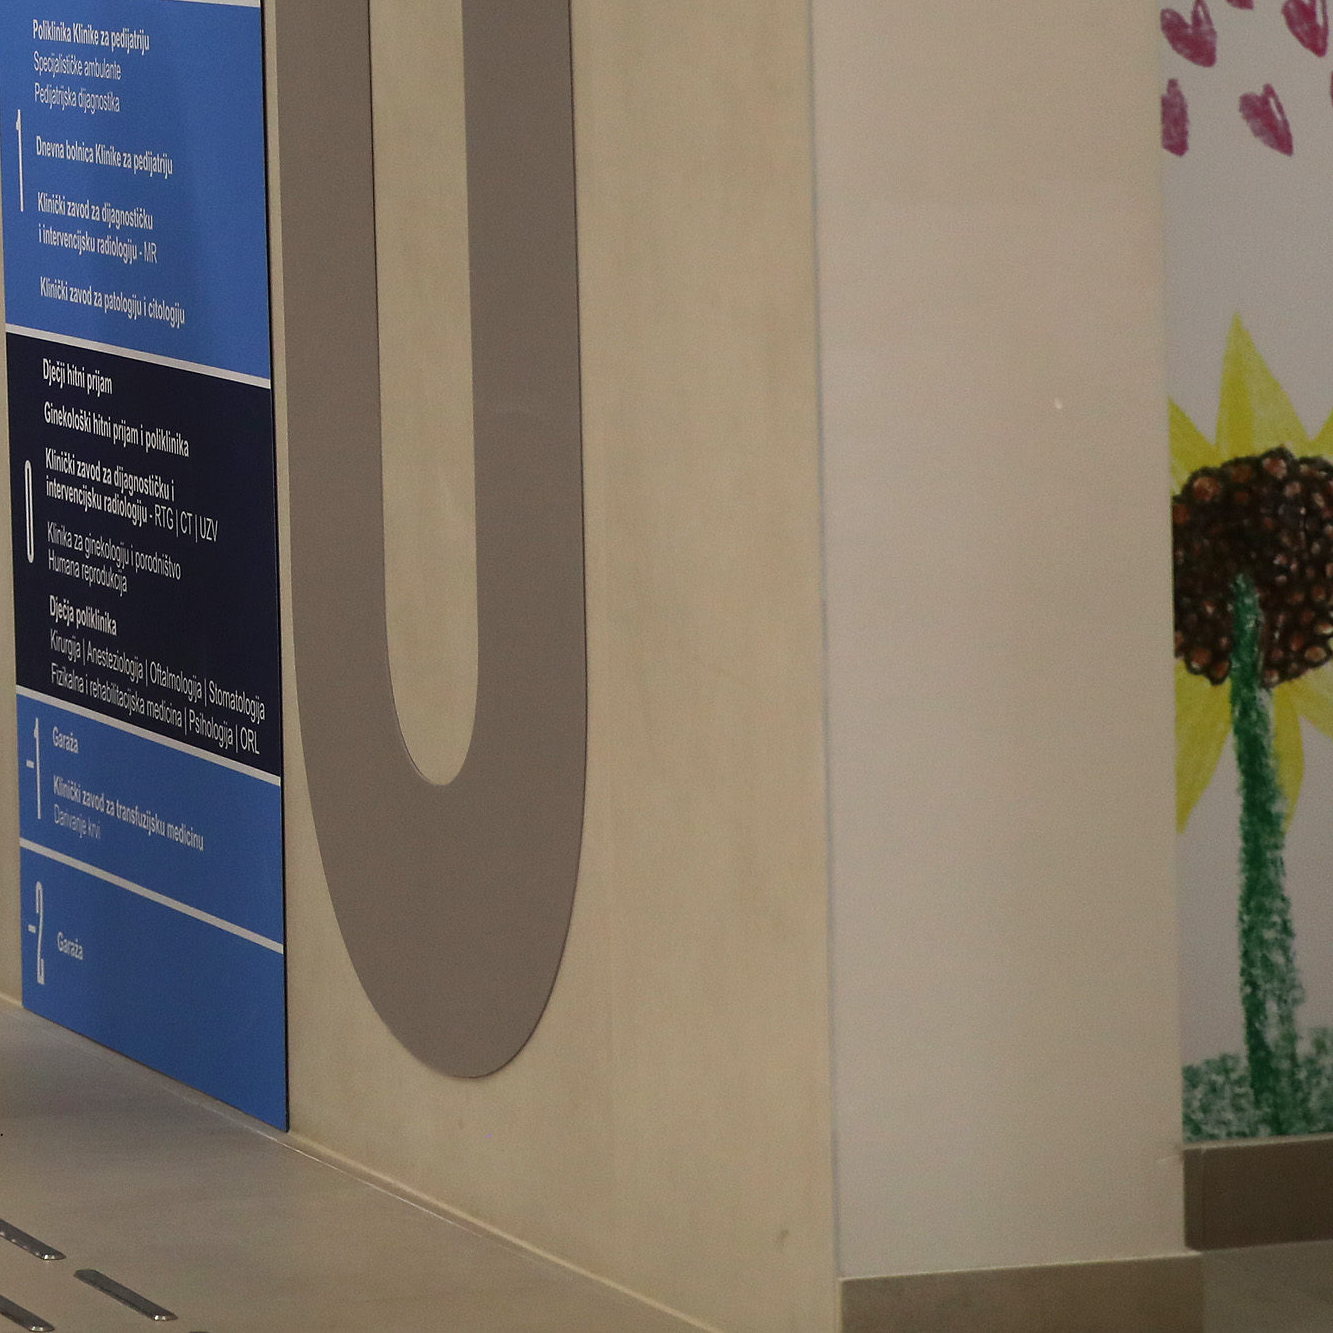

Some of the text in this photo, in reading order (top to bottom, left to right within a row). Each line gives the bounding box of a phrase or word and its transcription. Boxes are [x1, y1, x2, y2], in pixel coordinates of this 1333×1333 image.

[33, 19, 149, 55] Poliklinika Klinike za pedijatriju
[16, 109, 23, 212] 1
[36, 136, 172, 179] Dnevna bolnica Klinike za pedijatriju
[38, 192, 153, 229] Klinički zavod za dijagnostičku
[43, 224, 157, 264] intervencijsku radiologiju MR
[41, 277, 184, 328] Klinički zavod za patologiju citologiju
[43, 358, 112, 397] Dječji hitni prijam
[44, 401, 189, 457] Ginekološki hitni prijam poliklinika
[46, 448, 170, 508] Klinički zavod za dijagnostičku
[25, 460, 34, 564] 0
[46, 475, 218, 541] intervencijsku radiologiju RTG CT UZV
[48, 521, 180, 580] Klinika za ginekologiju porodništvo
[49, 549, 127, 596] Humana reprodukcija
[50, 595, 116, 635] Dječja poliklinika
[51, 629, 265, 724] Kirurgija Anesteziologija Oftalmologija Stomatologija
[52, 663, 260, 754] Fizikalna rehabilitacijska medicina Psihologija ORL
[53, 726, 78, 753] Garaža
[54, 775, 203, 851] Klinički zavod za transfuzijsku medicinu
[57, 932, 83, 960] Garaža
